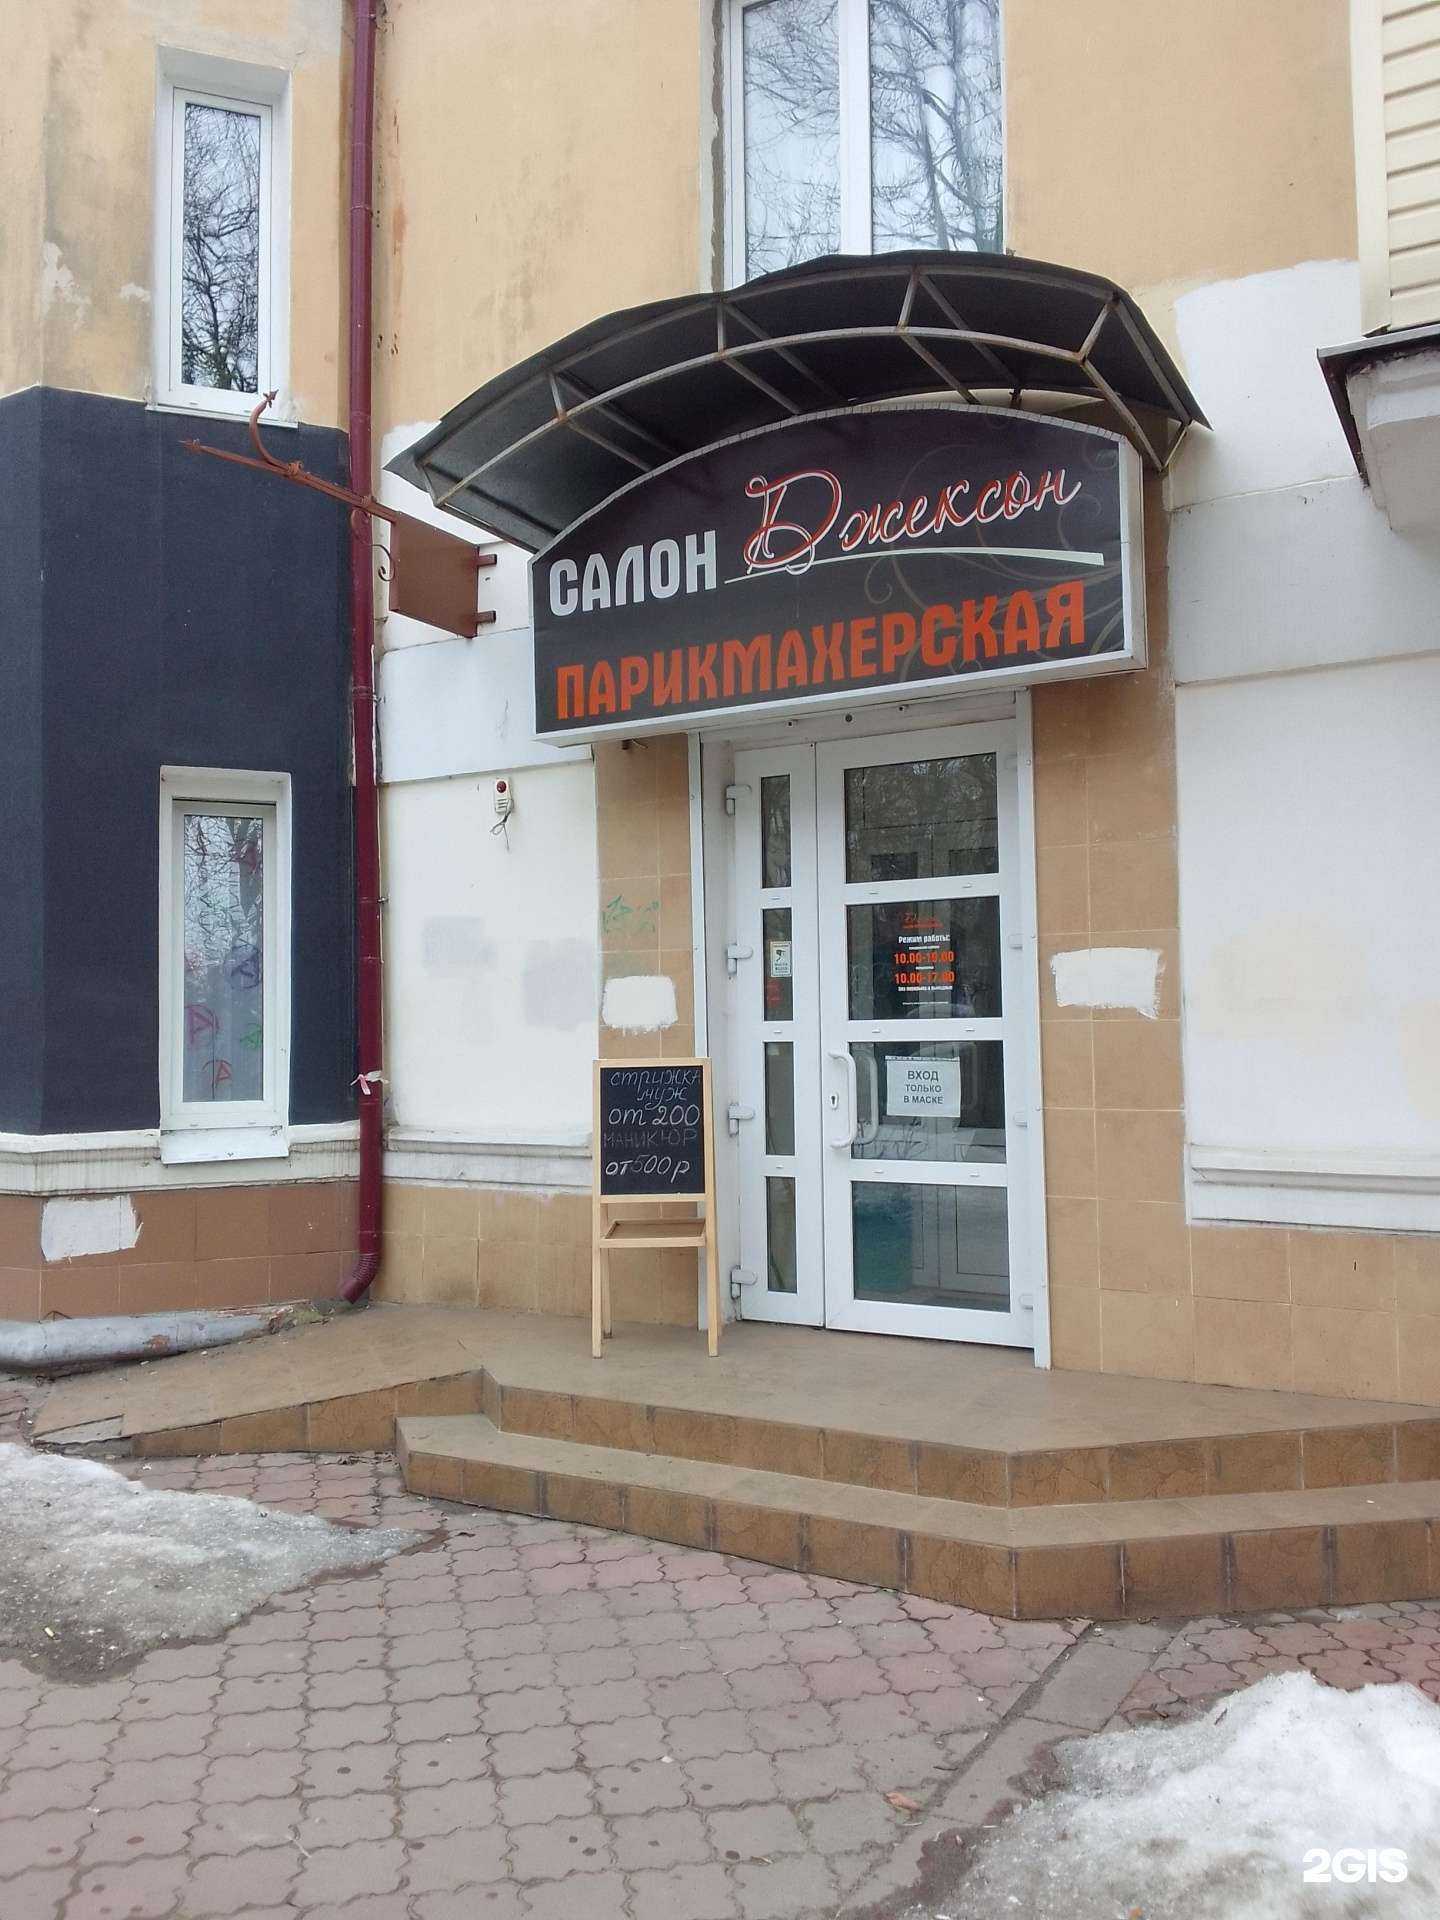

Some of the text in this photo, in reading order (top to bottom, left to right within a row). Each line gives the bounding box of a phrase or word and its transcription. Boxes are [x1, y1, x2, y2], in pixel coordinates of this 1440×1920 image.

[548, 467, 1083, 618] САЛОН Джексон
[556, 579, 1086, 720] ПАРИКМАХЕРСКАЯ
[907, 1070, 939, 1082] ВХОД
[905, 1084, 942, 1093] ТОЛЬКО
[903, 1095, 944, 1105] В МАСКЕ
[608, 1104, 701, 1126] от 200
